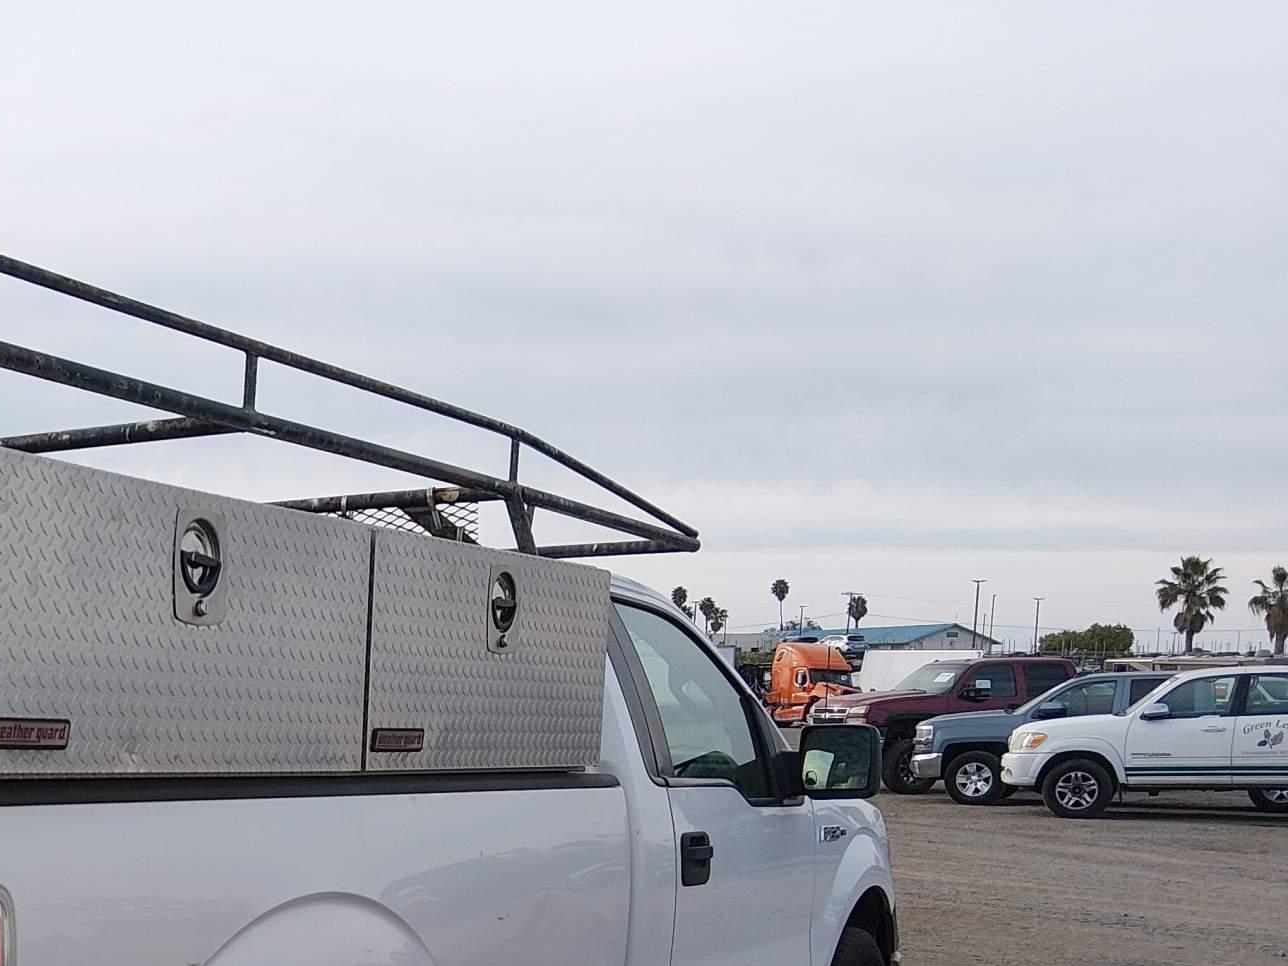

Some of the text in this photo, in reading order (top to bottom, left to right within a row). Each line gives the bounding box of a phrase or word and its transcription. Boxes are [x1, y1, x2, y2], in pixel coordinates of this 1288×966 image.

[36, 725, 67, 743] guard
[1243, 719, 1288, 735] Green Le
